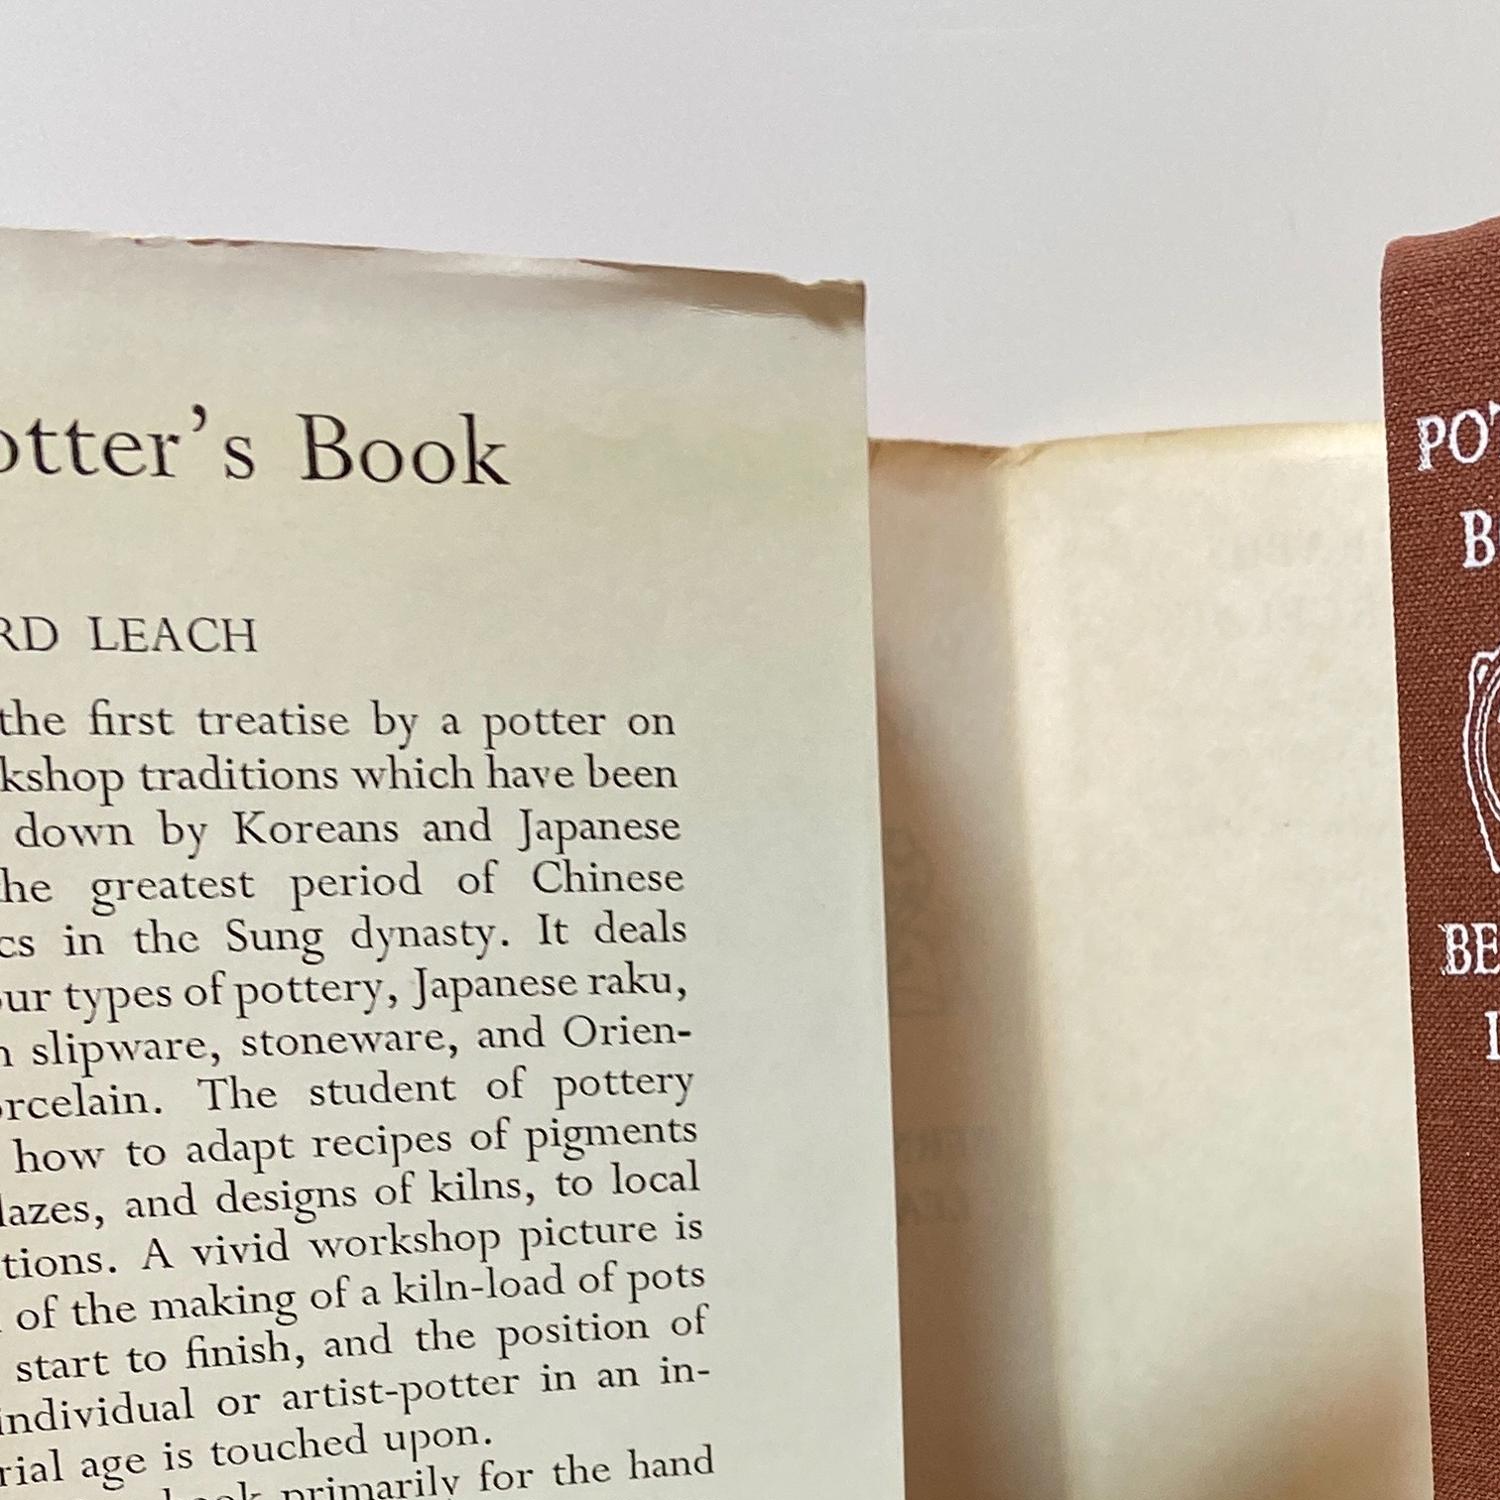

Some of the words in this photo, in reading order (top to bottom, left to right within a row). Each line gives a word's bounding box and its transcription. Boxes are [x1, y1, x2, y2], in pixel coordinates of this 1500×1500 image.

[296, 413, 511, 485] Book
[87, 616, 258, 652] LEACH
[88, 698, 175, 736] first
[197, 703, 350, 736] treatise
[370, 699, 419, 750] by
[441, 713, 462, 735] a
[482, 709, 606, 750] potter
[627, 714, 675, 736] on
[15, 811, 135, 848] down
[156, 809, 208, 860] by
[232, 811, 398, 844] Koreans
[423, 806, 492, 842] and
[517, 808, 681, 855] Japanese
[91, 872, 255, 917] greatest
[289, 860, 423, 912] period
[458, 859, 499, 895] of
[533, 858, 684, 893] Chinese
[63, 924, 104, 956] in
[133, 918, 200, 954] the
[226, 918, 325, 965] Sung
[351, 914, 509, 963] dynasty.
[537, 913, 569, 945] It
[594, 909, 687, 943] deals
[63, 983, 172, 1024] types
[184, 970, 226, 1006] of
[233, 976, 398, 1019] pottery,
[412, 967, 578, 1013] Japanese
[587, 960, 686, 1002] raku,
[197, 1075, 277, 1110] The
[310, 1069, 457, 1106] student
[487, 1065, 527, 1099] of
[553, 1070, 694, 1110] pottery
[11, 1138, 105, 1173] how
[126, 1141, 166, 1167] to
[187, 1128, 295, 1175] adapt
[311, 1125, 452, 1168] recipes
[470, 1116, 511, 1150] of
[523, 1118, 697, 1162] pigments
[141, 1238, 175, 1270] A
[190, 1227, 290, 1266] vivid
[308, 1219, 500, 1263] workshop
[518, 1217, 658, 1261] picture
[675, 1212, 702, 1240] is
[16, 1351, 110, 1382] start
[126, 1348, 166, 1373] to
[185, 1329, 304, 1369] finish,
[324, 1322, 393, 1357] and
[415, 1318, 476, 1351] the
[496, 1313, 650, 1360] position
[671, 1303, 709, 1336] of
[217, 1394, 261, 1416] or
[283, 1373, 520, 1415] artist-potter
[540, 1364, 576, 1392] in
[598, 1368, 640, 1388] an
[659, 1356, 710, 1384] in-
[81, 1454, 147, 1491] age
[162, 1442, 193, 1471] is
[210, 1422, 368, 1466] touched
[383, 1426, 491, 1463] upon.
